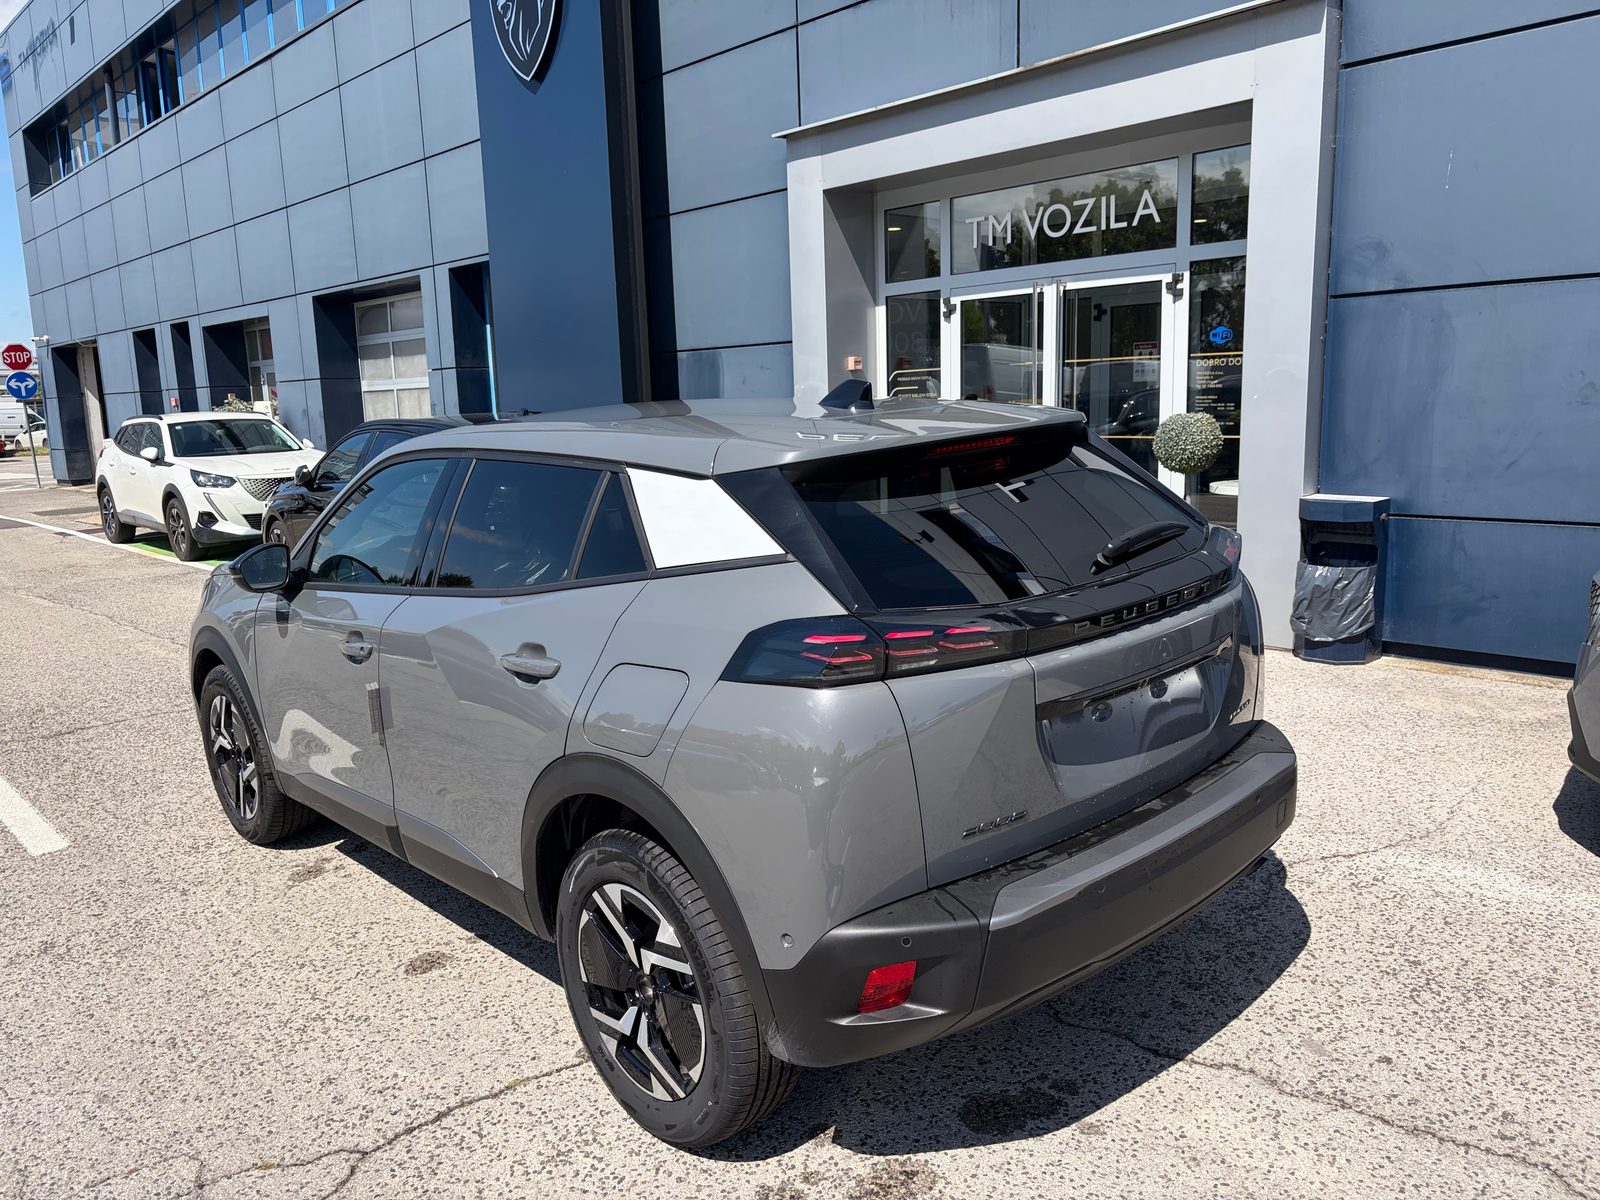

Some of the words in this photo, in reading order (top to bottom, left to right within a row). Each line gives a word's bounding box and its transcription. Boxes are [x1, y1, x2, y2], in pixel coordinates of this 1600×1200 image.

[965, 211, 1012, 248] TM
[1022, 189, 1161, 240] VOZILA
[3, 352, 30, 363] STOP
[1196, 358, 1227, 367] DOBRO
[1228, 357, 1242, 366] DO
[1072, 582, 1212, 634] PEUGEOT
